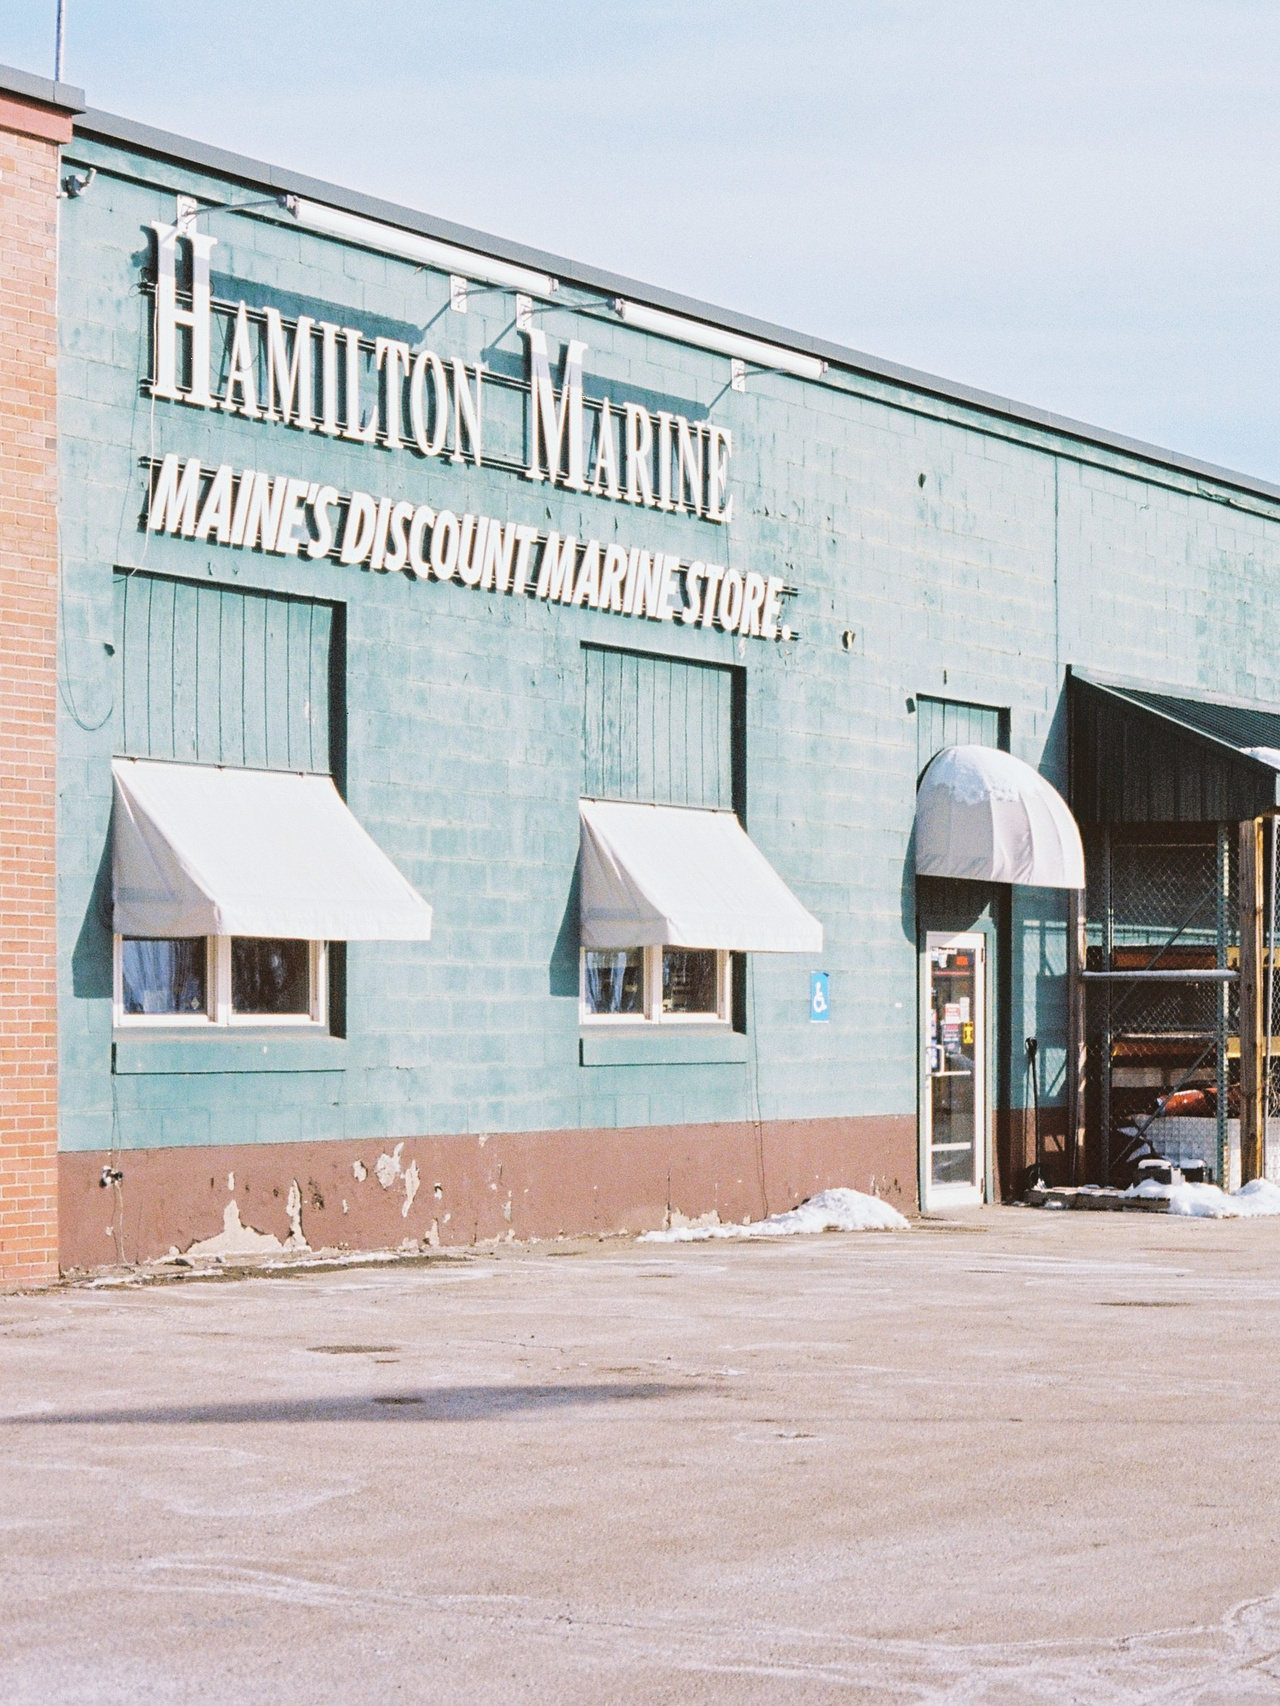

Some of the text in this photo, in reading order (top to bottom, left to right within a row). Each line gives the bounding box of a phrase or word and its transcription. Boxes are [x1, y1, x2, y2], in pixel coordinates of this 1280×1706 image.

[150, 220, 734, 523] HAMILTON MARINE
[149, 453, 793, 641] MAINE'S DISCOUNT MARINE STORE.
